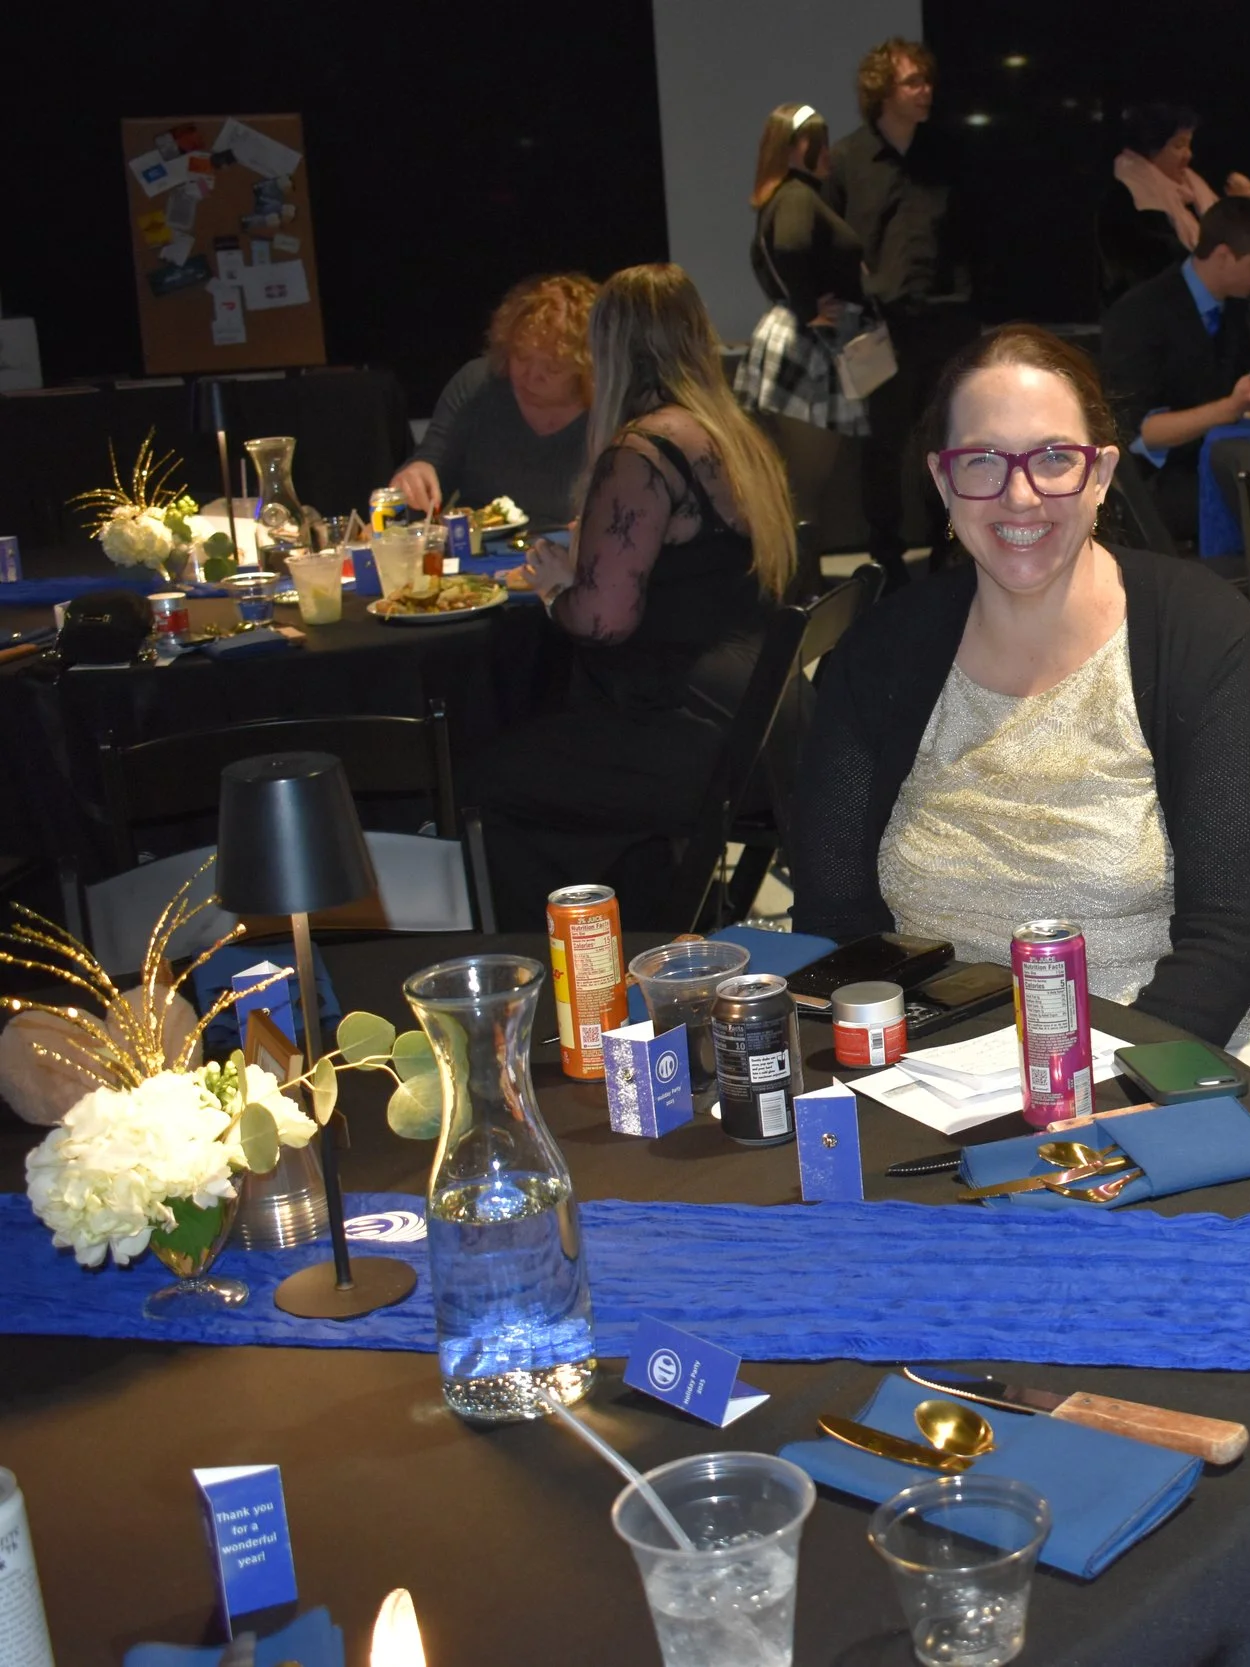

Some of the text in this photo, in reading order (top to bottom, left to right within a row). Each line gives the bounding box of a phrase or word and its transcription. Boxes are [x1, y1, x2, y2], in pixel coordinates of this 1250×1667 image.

[595, 921, 609, 929] Facts
[603, 936, 610, 945] 15
[1024, 981, 1045, 989] Calories
[1060, 979, 1065, 988] 5
[735, 1042, 746, 1051] 10
[684, 1359, 701, 1404] Holiday Party
[216, 1502, 274, 1523] Thank you
[232, 1522, 259, 1536] for a
[222, 1531, 277, 1555] wonderful
[238, 1550, 266, 1569] year!
